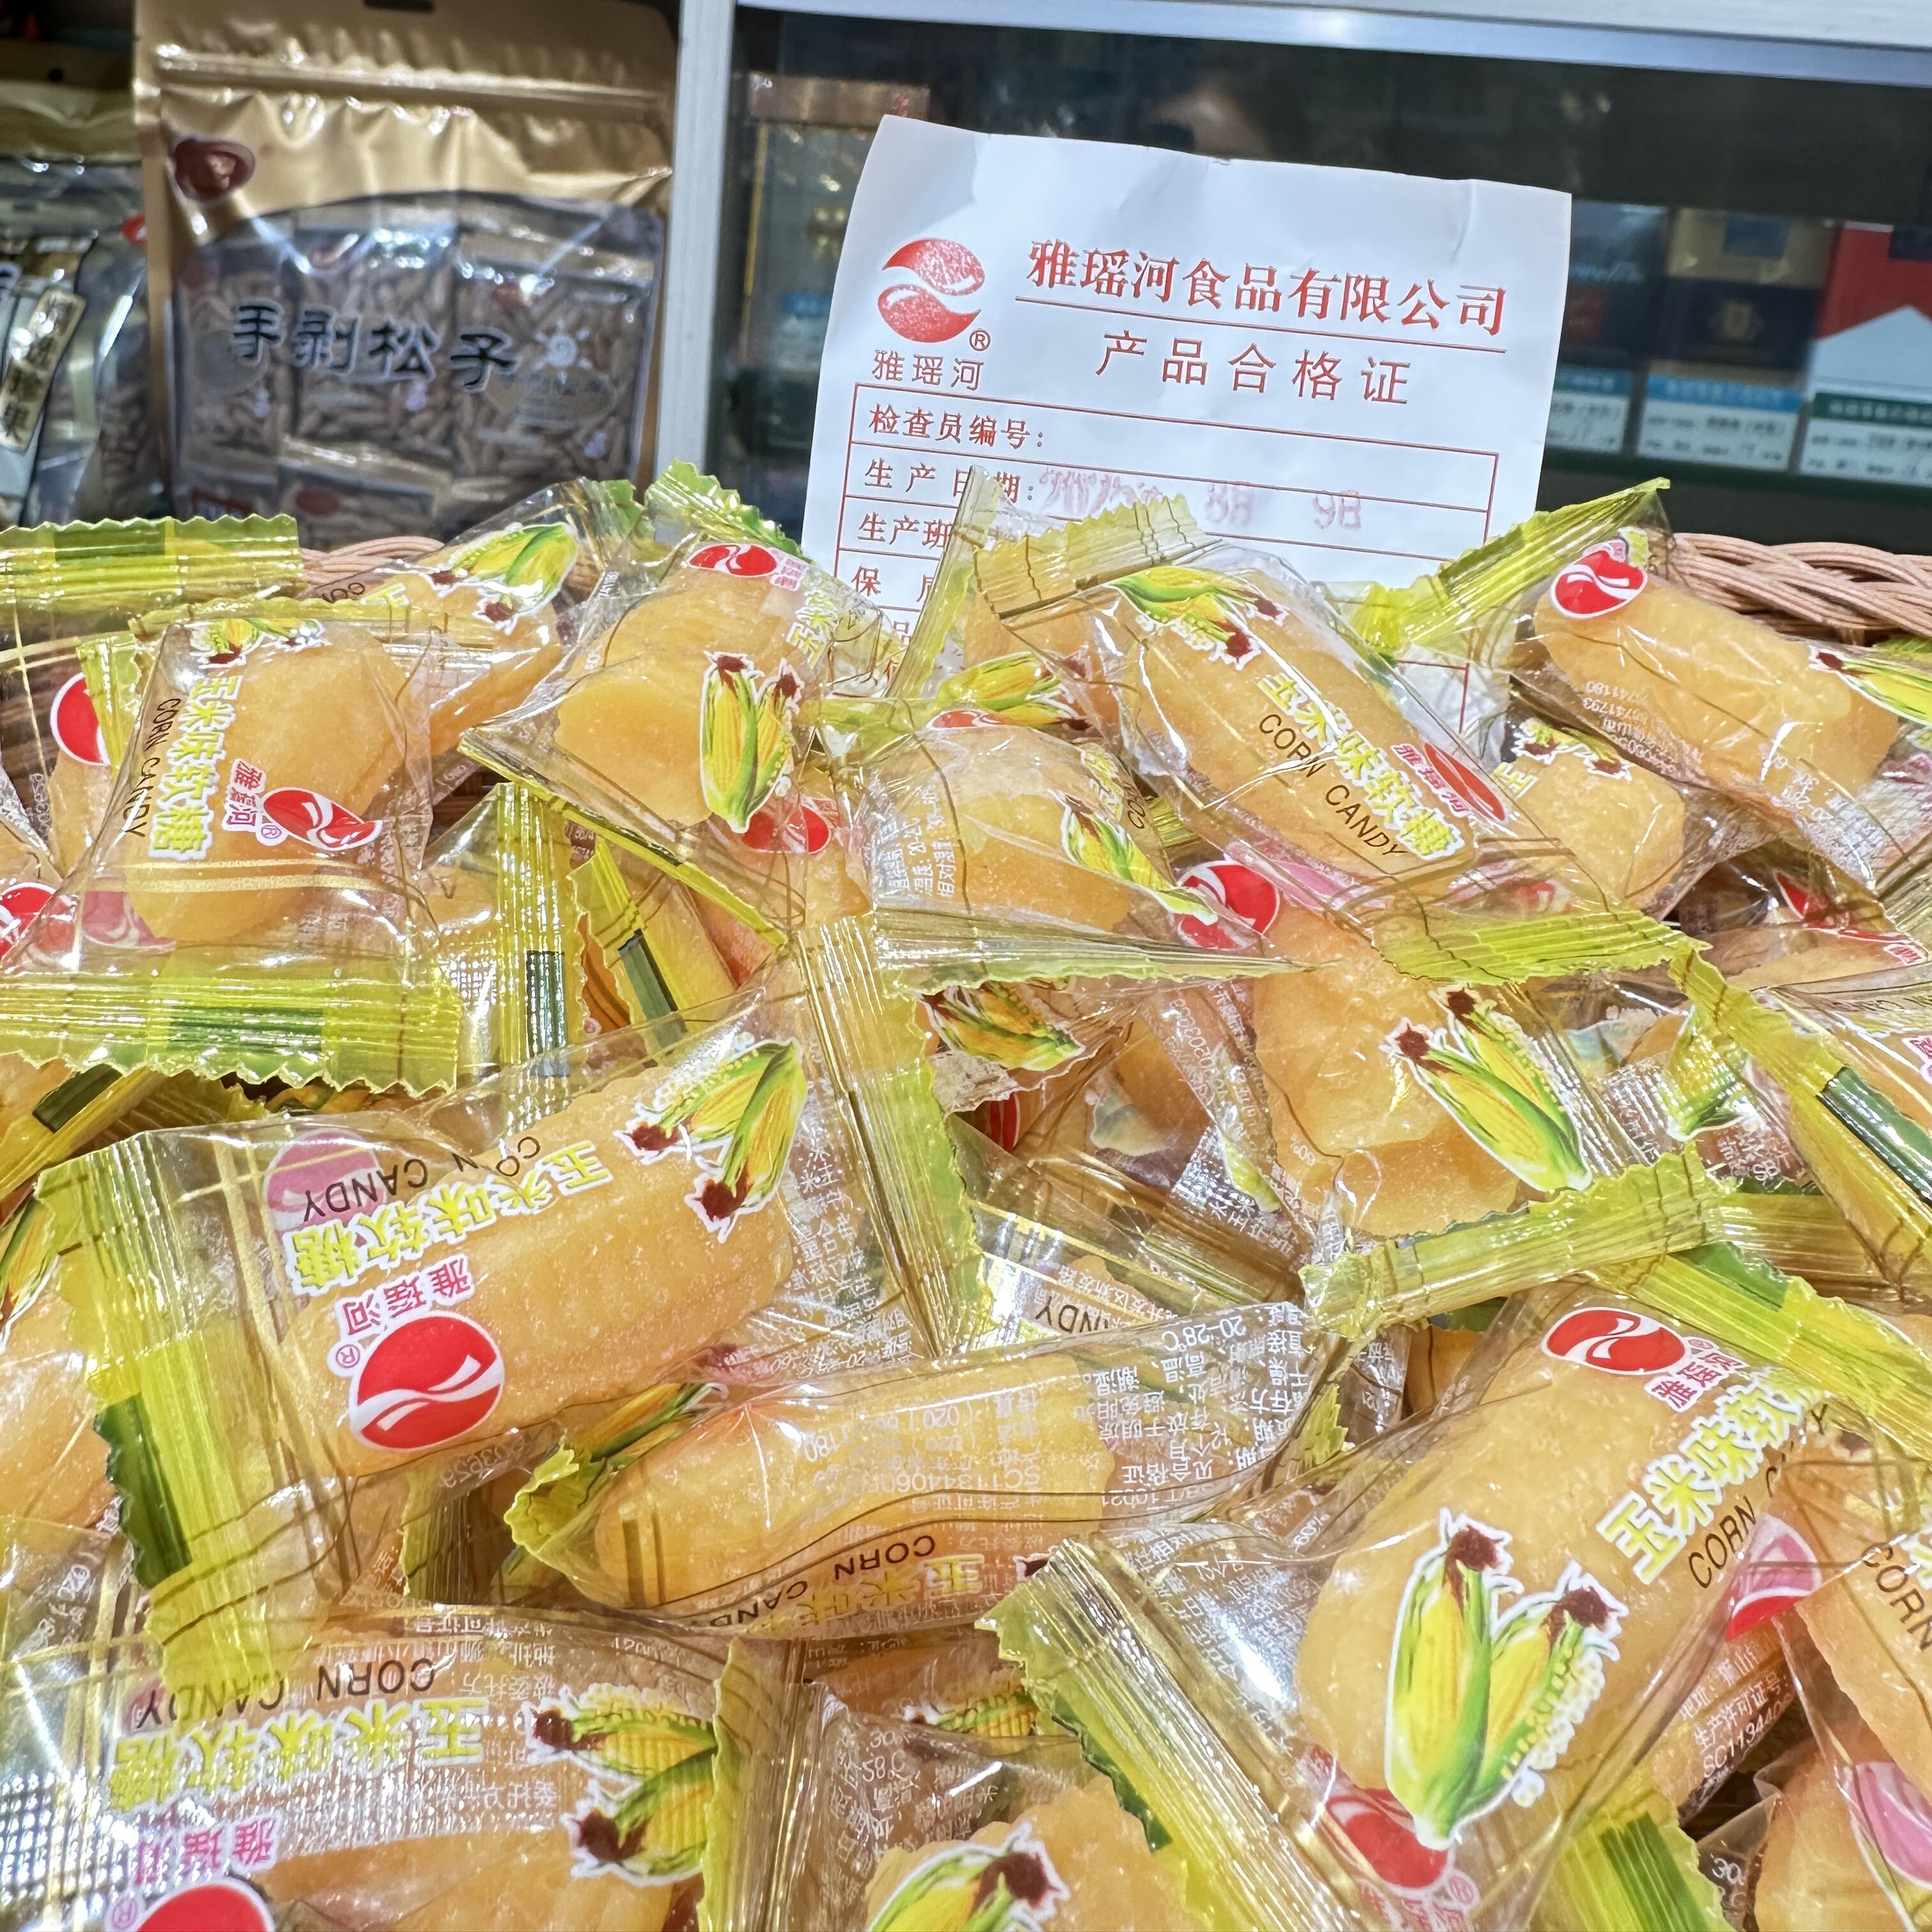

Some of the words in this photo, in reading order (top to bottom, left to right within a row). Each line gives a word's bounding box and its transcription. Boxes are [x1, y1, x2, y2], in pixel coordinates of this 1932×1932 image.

[1027, 239, 1506, 336] 雅瑶河食品有限公司
[231, 300, 519, 392] 手剥松子
[873, 349, 985, 391] 雅瑶河
[1095, 328, 1411, 404] 产品合格证
[870, 403, 1043, 448] 检查员编号：
[144, 698, 181, 752] CORN
[123, 757, 160, 837] CANDY
[150, 675, 242, 859] 玉米味软糖
[1259, 714, 1327, 778] CORN
[1325, 784, 1408, 855] CANDY
[303, 1158, 428, 1222] CANDY
[452, 1136, 540, 1177] CON
[285, 1139, 612, 1294] 玉米味软糖
[342, 1256, 473, 1337] 雅瑶河
[834, 1535, 935, 1580] CORN
[1689, 1496, 1757, 1588] CORN
[1860, 1541, 1931, 1652] CORN
[317, 1658, 435, 1699] CORN
